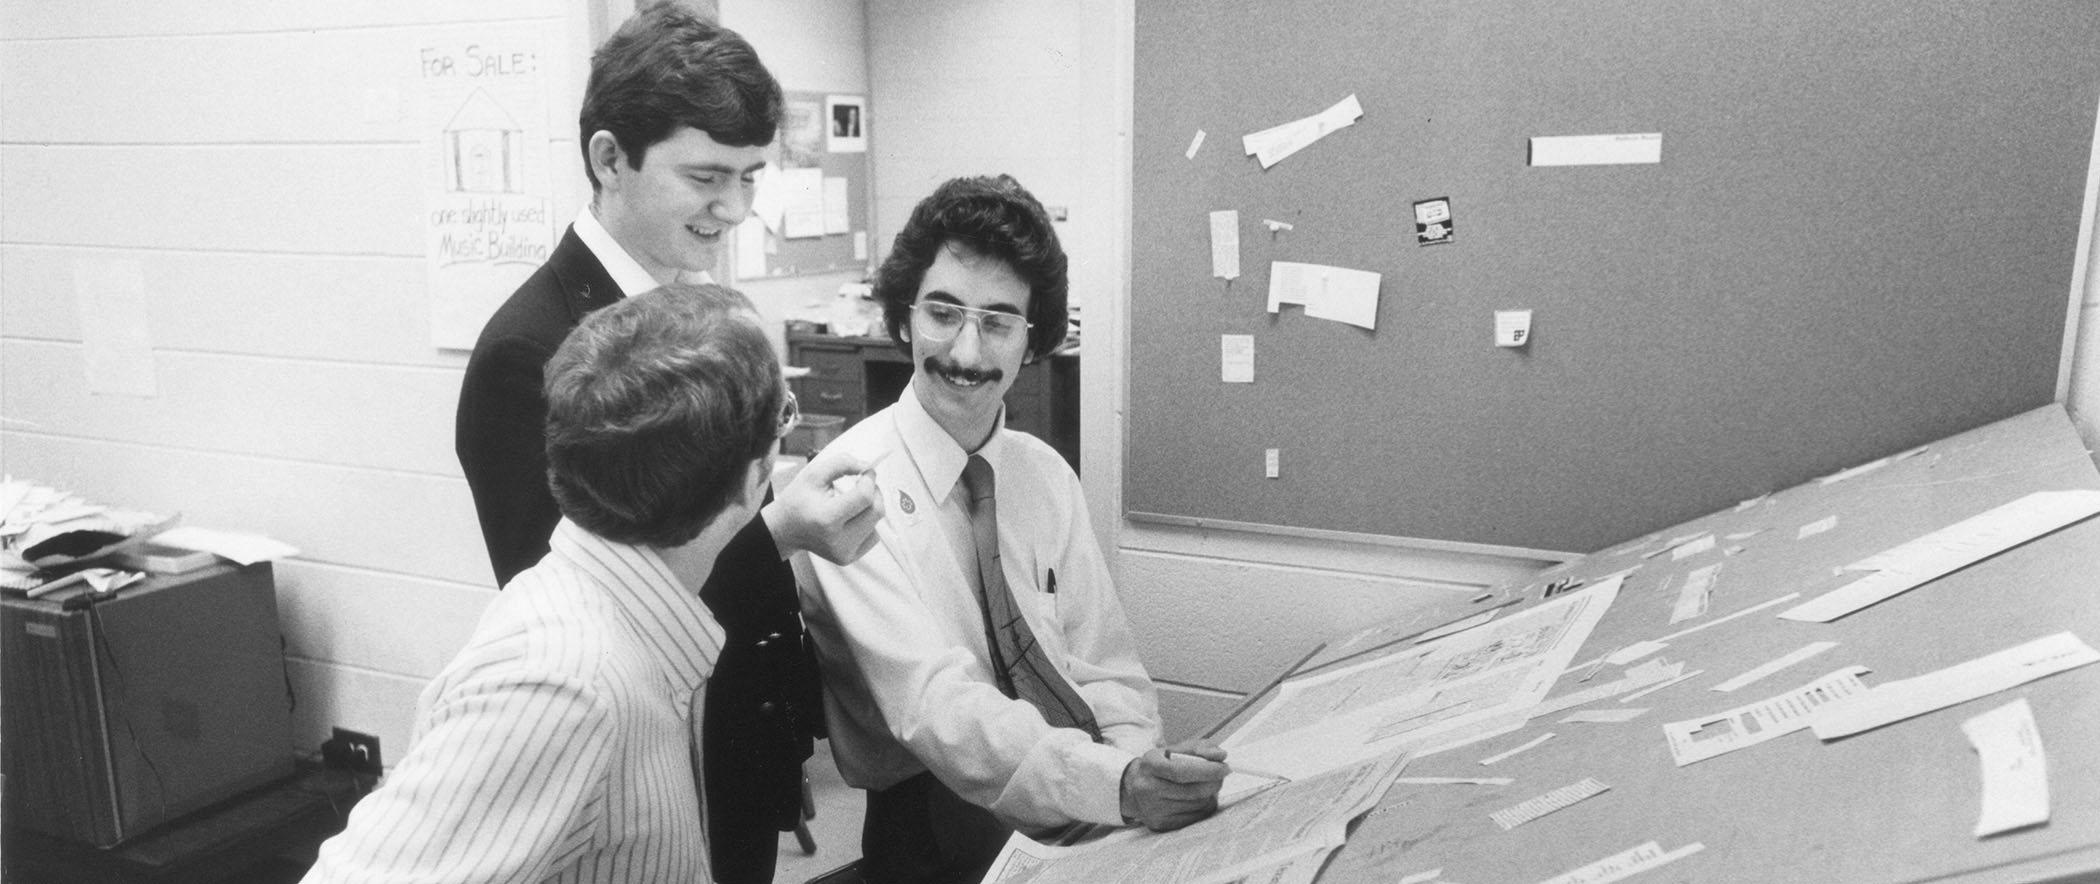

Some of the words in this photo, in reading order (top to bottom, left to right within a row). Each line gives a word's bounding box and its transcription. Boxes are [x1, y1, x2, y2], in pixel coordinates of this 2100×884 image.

[431, 207, 457, 227] one
[461, 198, 508, 234] slightly
[511, 198, 545, 225] used
[437, 231, 484, 260] Music
[488, 230, 547, 260] Building
